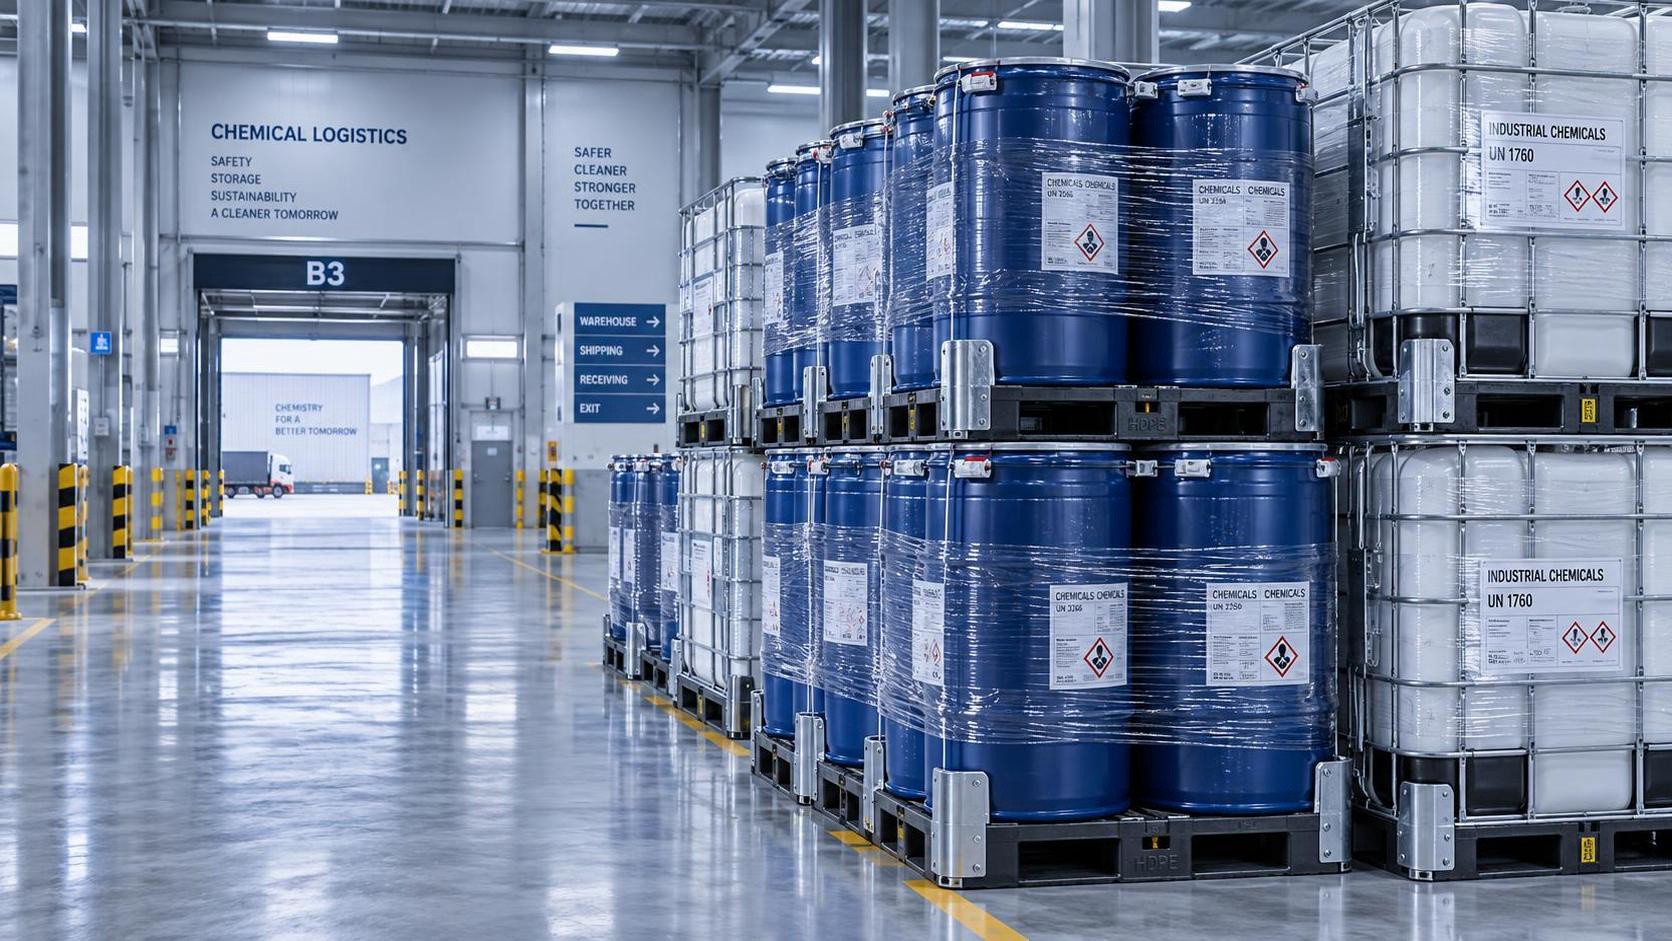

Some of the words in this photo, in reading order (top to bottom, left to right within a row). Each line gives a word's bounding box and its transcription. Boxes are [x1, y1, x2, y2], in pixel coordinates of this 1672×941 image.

[211, 123, 307, 142] CHEMICAL
[313, 126, 408, 144] LOGISTICS
[1489, 122, 1548, 138] INDUSTRIAL
[1551, 125, 1606, 141] CHEMICALS
[574, 146, 612, 158] SAFER
[1489, 146, 1506, 161] UN
[1508, 148, 1534, 162] 1760
[211, 155, 252, 167] SAFETY
[574, 164, 627, 176] CLEANER
[211, 173, 262, 185] STORAGE
[574, 181, 636, 193] STRONGER
[1198, 185, 1241, 194] CHEMICALS
[211, 190, 297, 203] SUSTAINABILITY
[574, 199, 635, 211] TOGETHER
[210, 207, 219, 219] A
[221, 208, 271, 220] CLEANER
[273, 209, 339, 221] TOMORROW
[306, 260, 345, 286] B3
[579, 316, 637, 327] WAREHOUSE
[579, 345, 623, 356] SHIPPING
[579, 375, 628, 385] RECEIVING
[275, 403, 323, 412] CHEMISTRY
[579, 403, 601, 414] EXIT
[275, 415, 292, 424] FOR
[294, 415, 301, 424] A
[275, 427, 306, 436] BETTER
[308, 427, 357, 436] TOMORROW
[1487, 569, 1547, 583] INDUSTRIAL
[1549, 568, 1604, 582] CHEMICALS
[1056, 592, 1095, 601] CHEMICALS
[1212, 589, 1257, 599] CHEMICALS
[1487, 594, 1504, 608] UN
[1507, 593, 1533, 607] 1760
[1056, 604, 1066, 612] UN
[1213, 603, 1224, 611] UN
